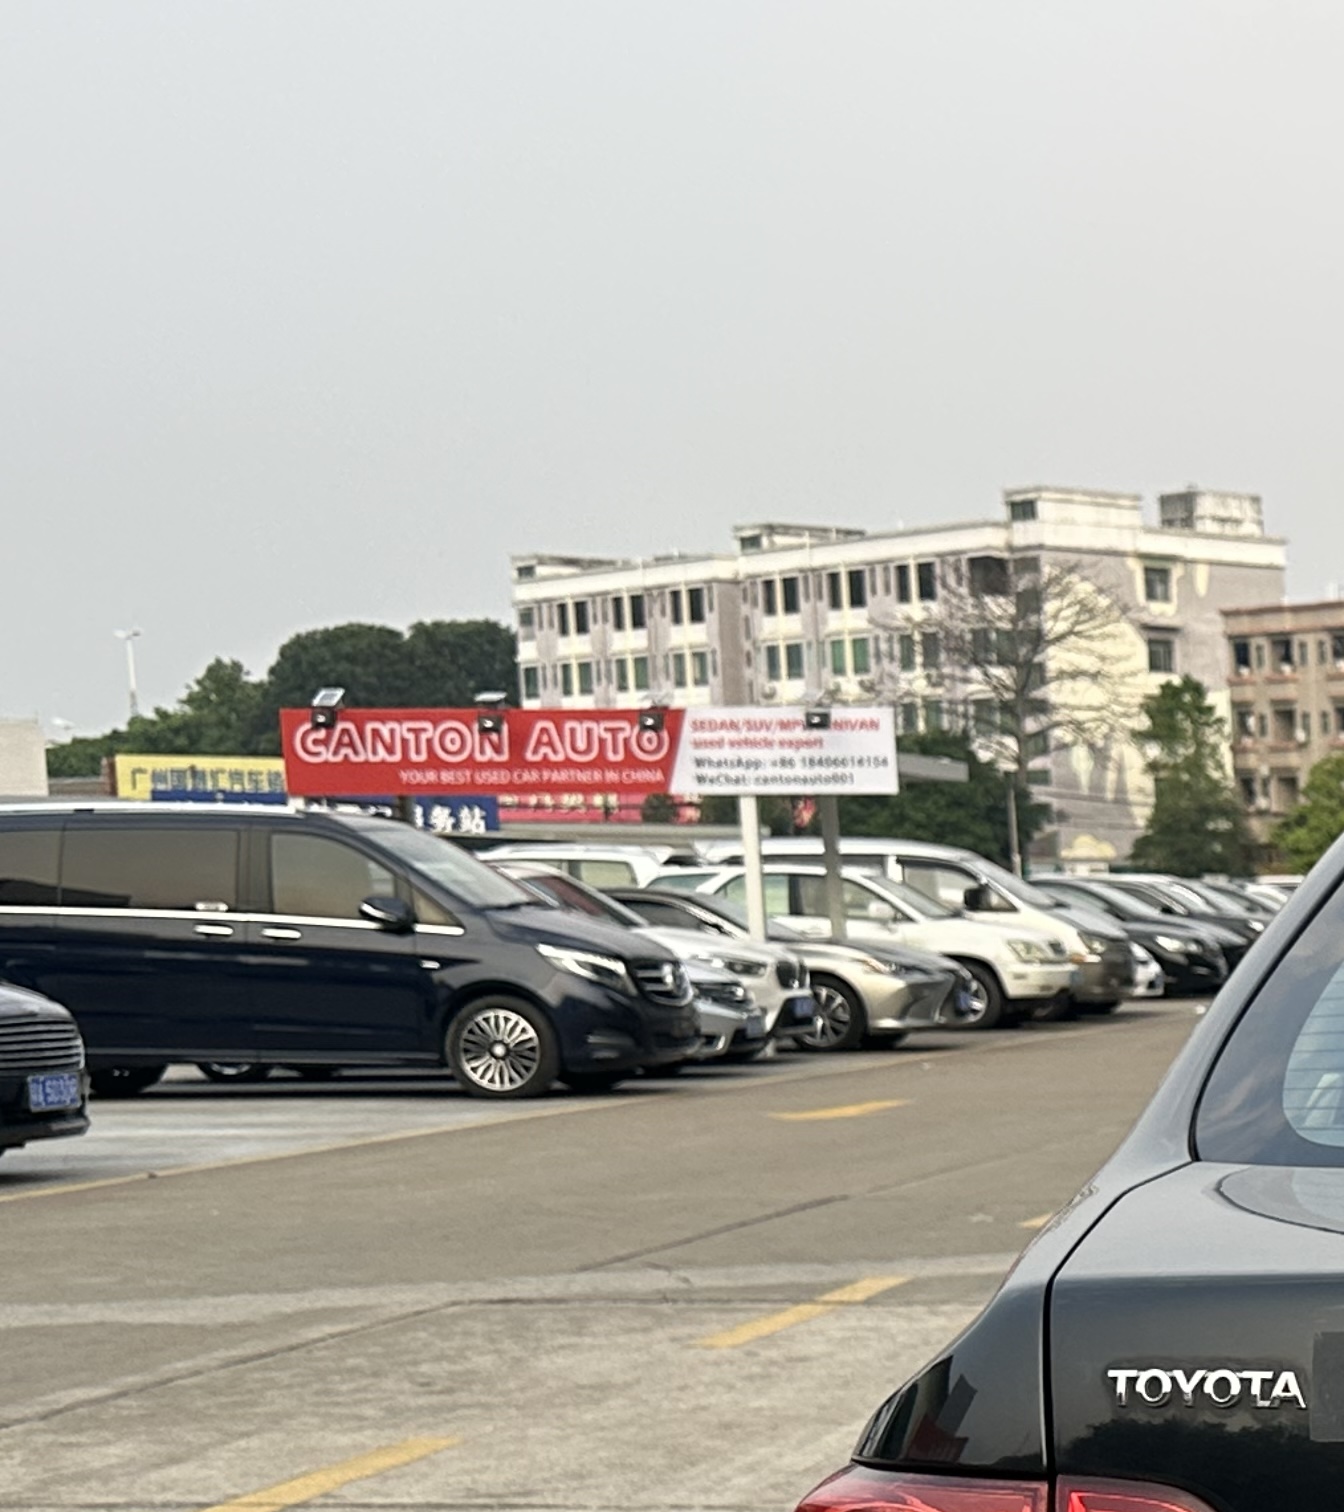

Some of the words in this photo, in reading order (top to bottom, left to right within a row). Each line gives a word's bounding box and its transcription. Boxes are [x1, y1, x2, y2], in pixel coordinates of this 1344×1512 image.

[294, 720, 509, 762] CANTON
[525, 720, 670, 762] AUTO
[399, 768, 438, 784] YOUR
[440, 768, 472, 785] BEST
[474, 768, 510, 785] USED
[512, 768, 541, 785] CAR
[542, 768, 602, 785] PARTNER
[604, 769, 620, 785] IN
[621, 769, 665, 785] CHINA
[1106, 1368, 1307, 1409] TOYOTA
